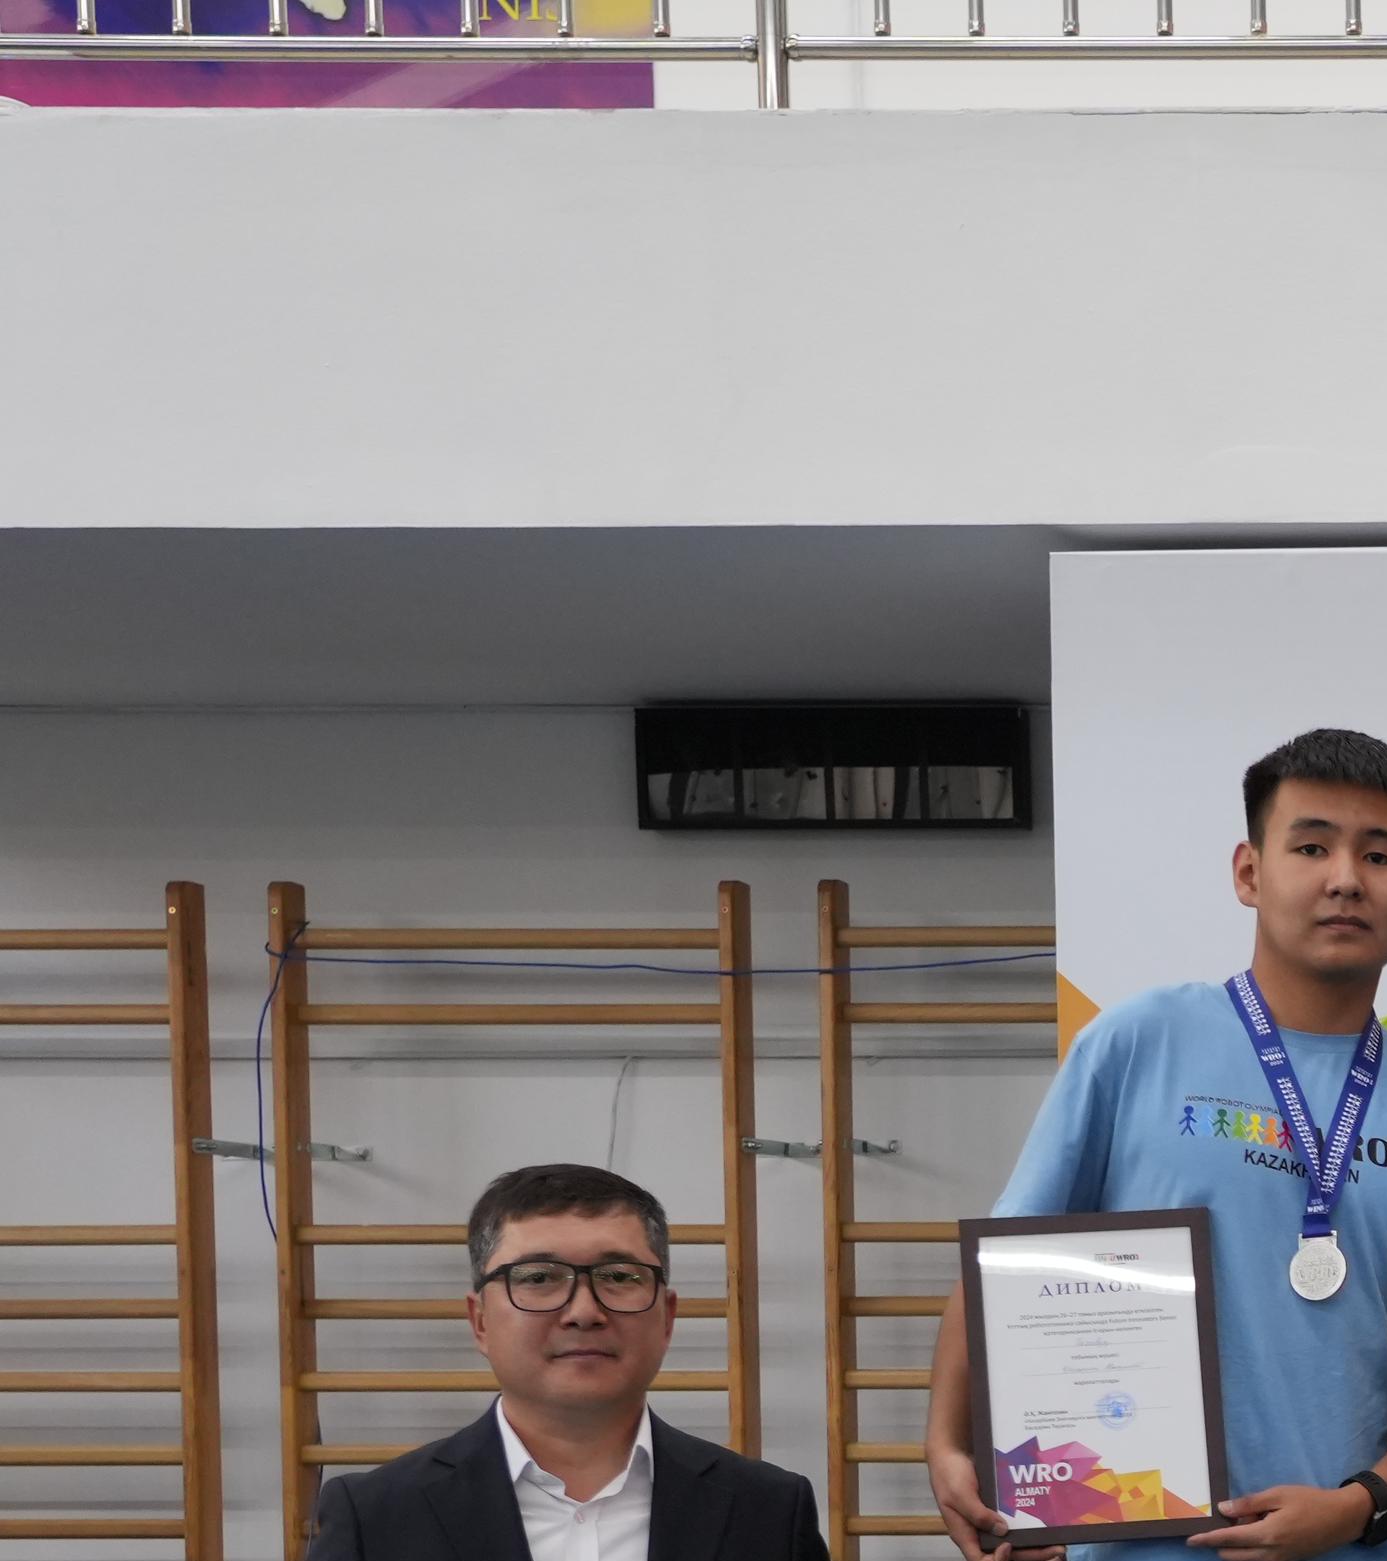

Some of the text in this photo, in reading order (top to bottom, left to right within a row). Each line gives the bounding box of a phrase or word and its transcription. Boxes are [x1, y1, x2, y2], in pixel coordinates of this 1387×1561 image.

[1009, 1462, 1073, 1484] WRO
[1015, 1486, 1051, 1497] ALMATY
[1015, 1498, 1035, 1508] 2024
